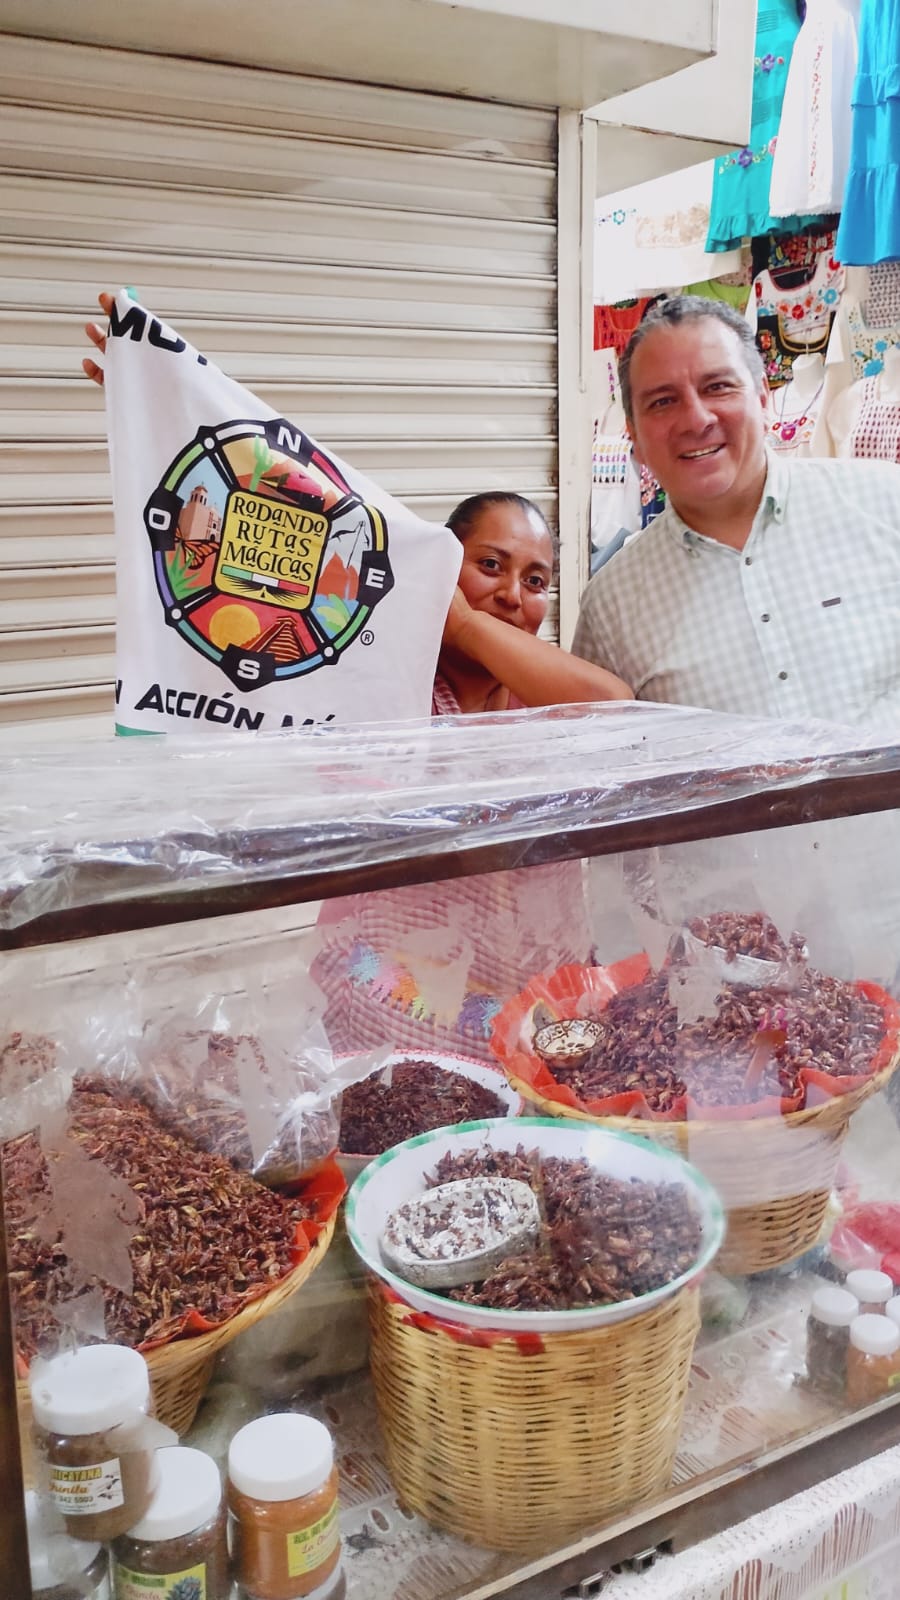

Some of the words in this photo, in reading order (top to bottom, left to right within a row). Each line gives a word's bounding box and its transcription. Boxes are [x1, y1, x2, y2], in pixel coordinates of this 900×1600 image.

[277, 426, 302, 453] N
[148, 507, 172, 531] O
[365, 567, 386, 589] E
[236, 658, 260, 680] S
[134, 683, 265, 730] ACCIÓN
